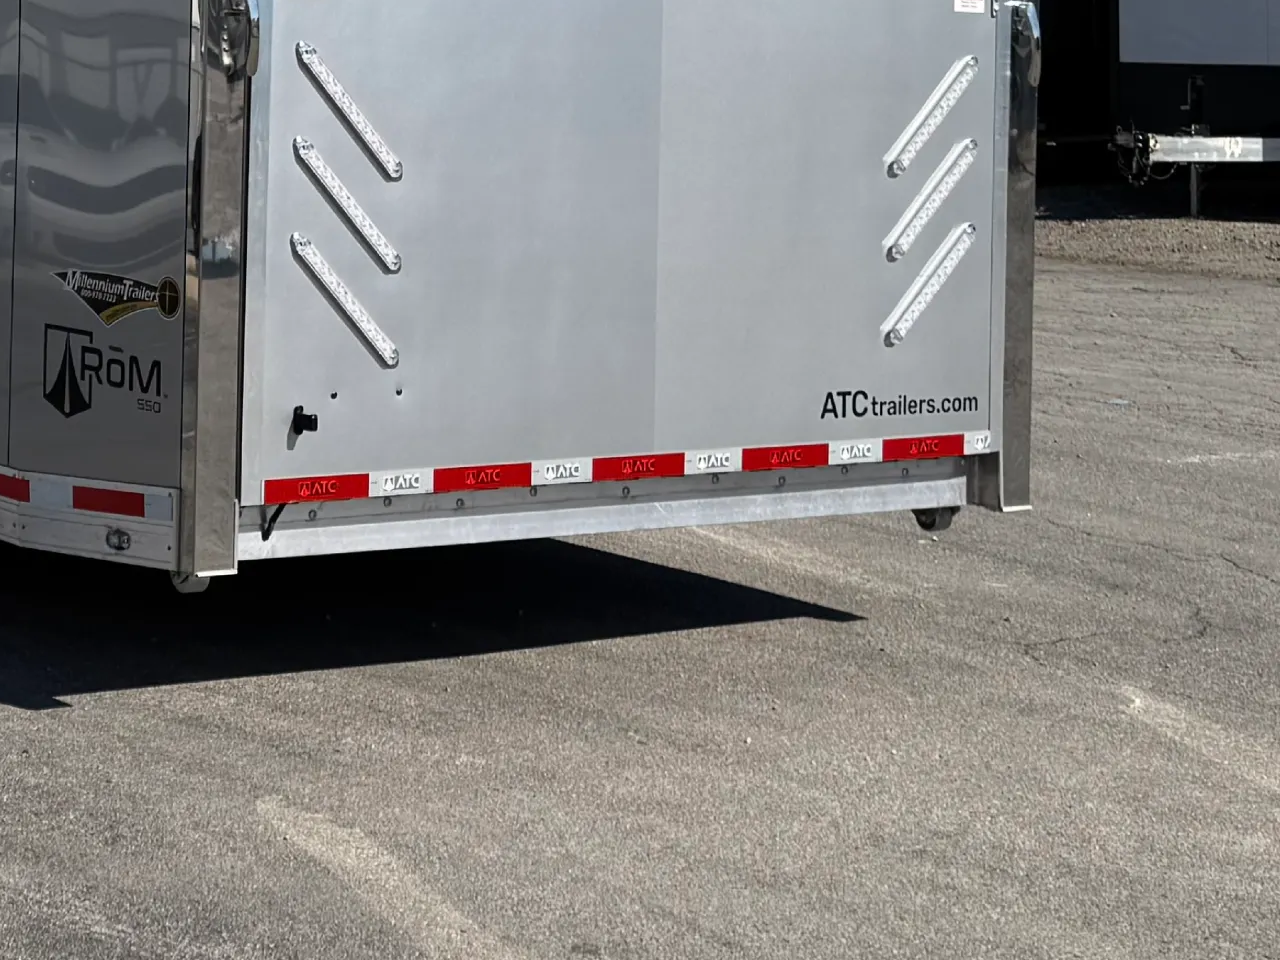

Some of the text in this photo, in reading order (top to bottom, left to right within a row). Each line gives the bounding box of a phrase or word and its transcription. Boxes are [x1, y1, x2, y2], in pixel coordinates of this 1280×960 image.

[137, 398, 161, 414] 550
[850, 444, 873, 458] ATC
[919, 440, 940, 453] ATC
[708, 452, 731, 468] ATC
[781, 449, 802, 463] ATC
[557, 462, 580, 479] ATC
[634, 458, 656, 472] ATC
[396, 473, 420, 489] ATC
[478, 469, 501, 483] ATC
[312, 480, 337, 495] ATC
